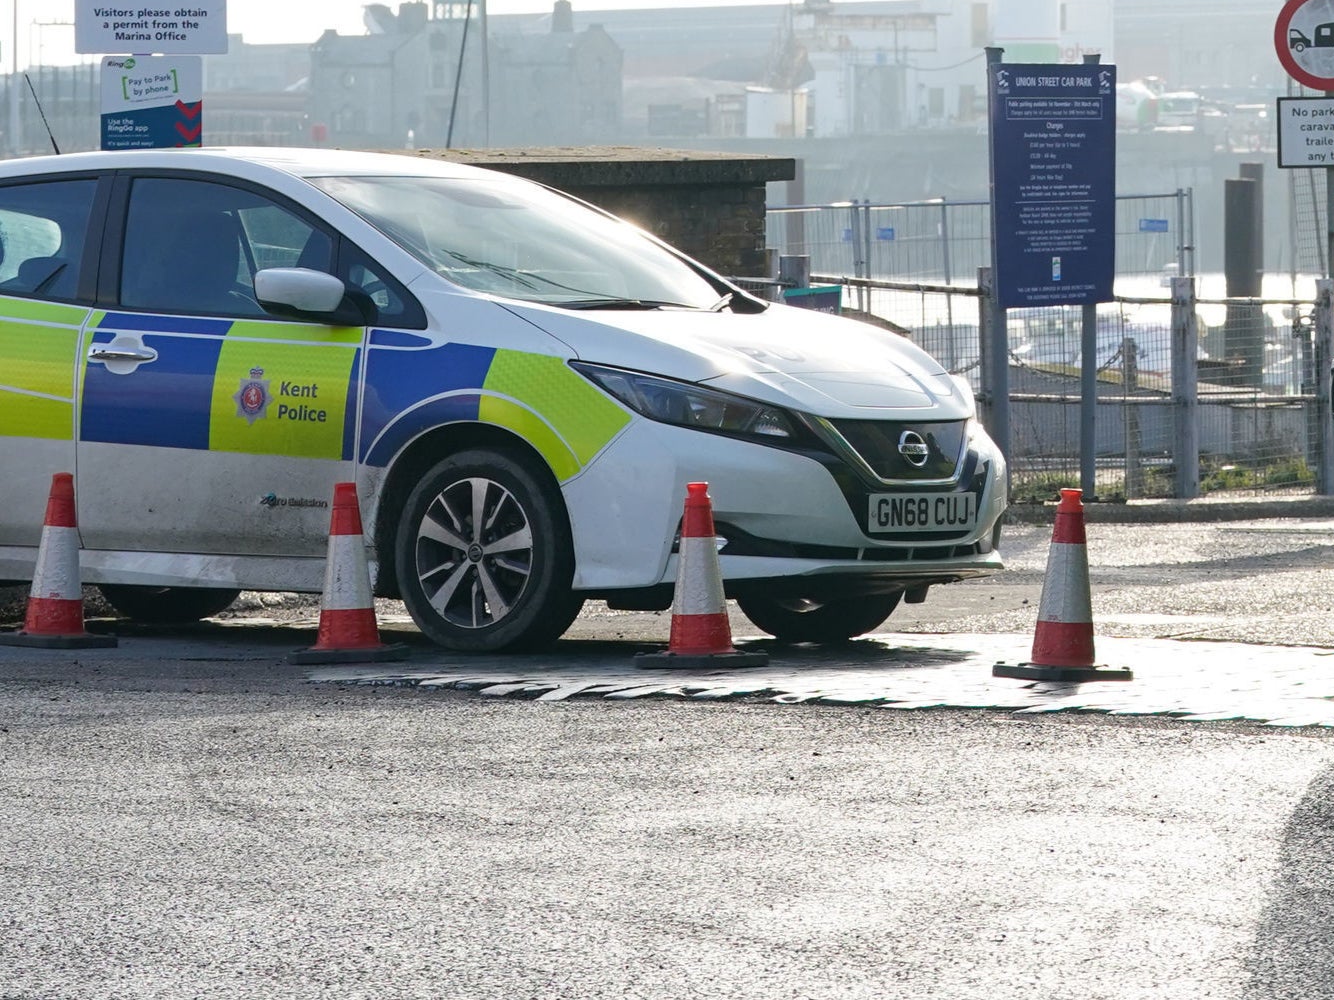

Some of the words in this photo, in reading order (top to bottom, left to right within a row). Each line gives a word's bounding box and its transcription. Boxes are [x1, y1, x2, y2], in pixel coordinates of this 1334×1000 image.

[94, 8, 133, 17] Visitors
[137, 8, 170, 19] please
[174, 8, 208, 18] obtain
[113, 20, 148, 30] permit
[152, 20, 178, 29] from
[182, 20, 199, 29] the
[115, 32, 151, 41] Marina
[155, 32, 187, 41] Office
[154, 74, 171, 82] Park
[1015, 77, 1036, 87] UNION
[1038, 77, 1060, 87] STREET
[1061, 77, 1075, 87] CAR
[1076, 77, 1092, 87] PARK
[145, 86, 169, 95] phone
[1292, 108, 1308, 116] No
[1308, 153, 1326, 161] any
[280, 381, 318, 398] Kent
[278, 405, 327, 422] Police
[878, 498, 929, 526] GN68
[935, 497, 969, 525] CUJ
